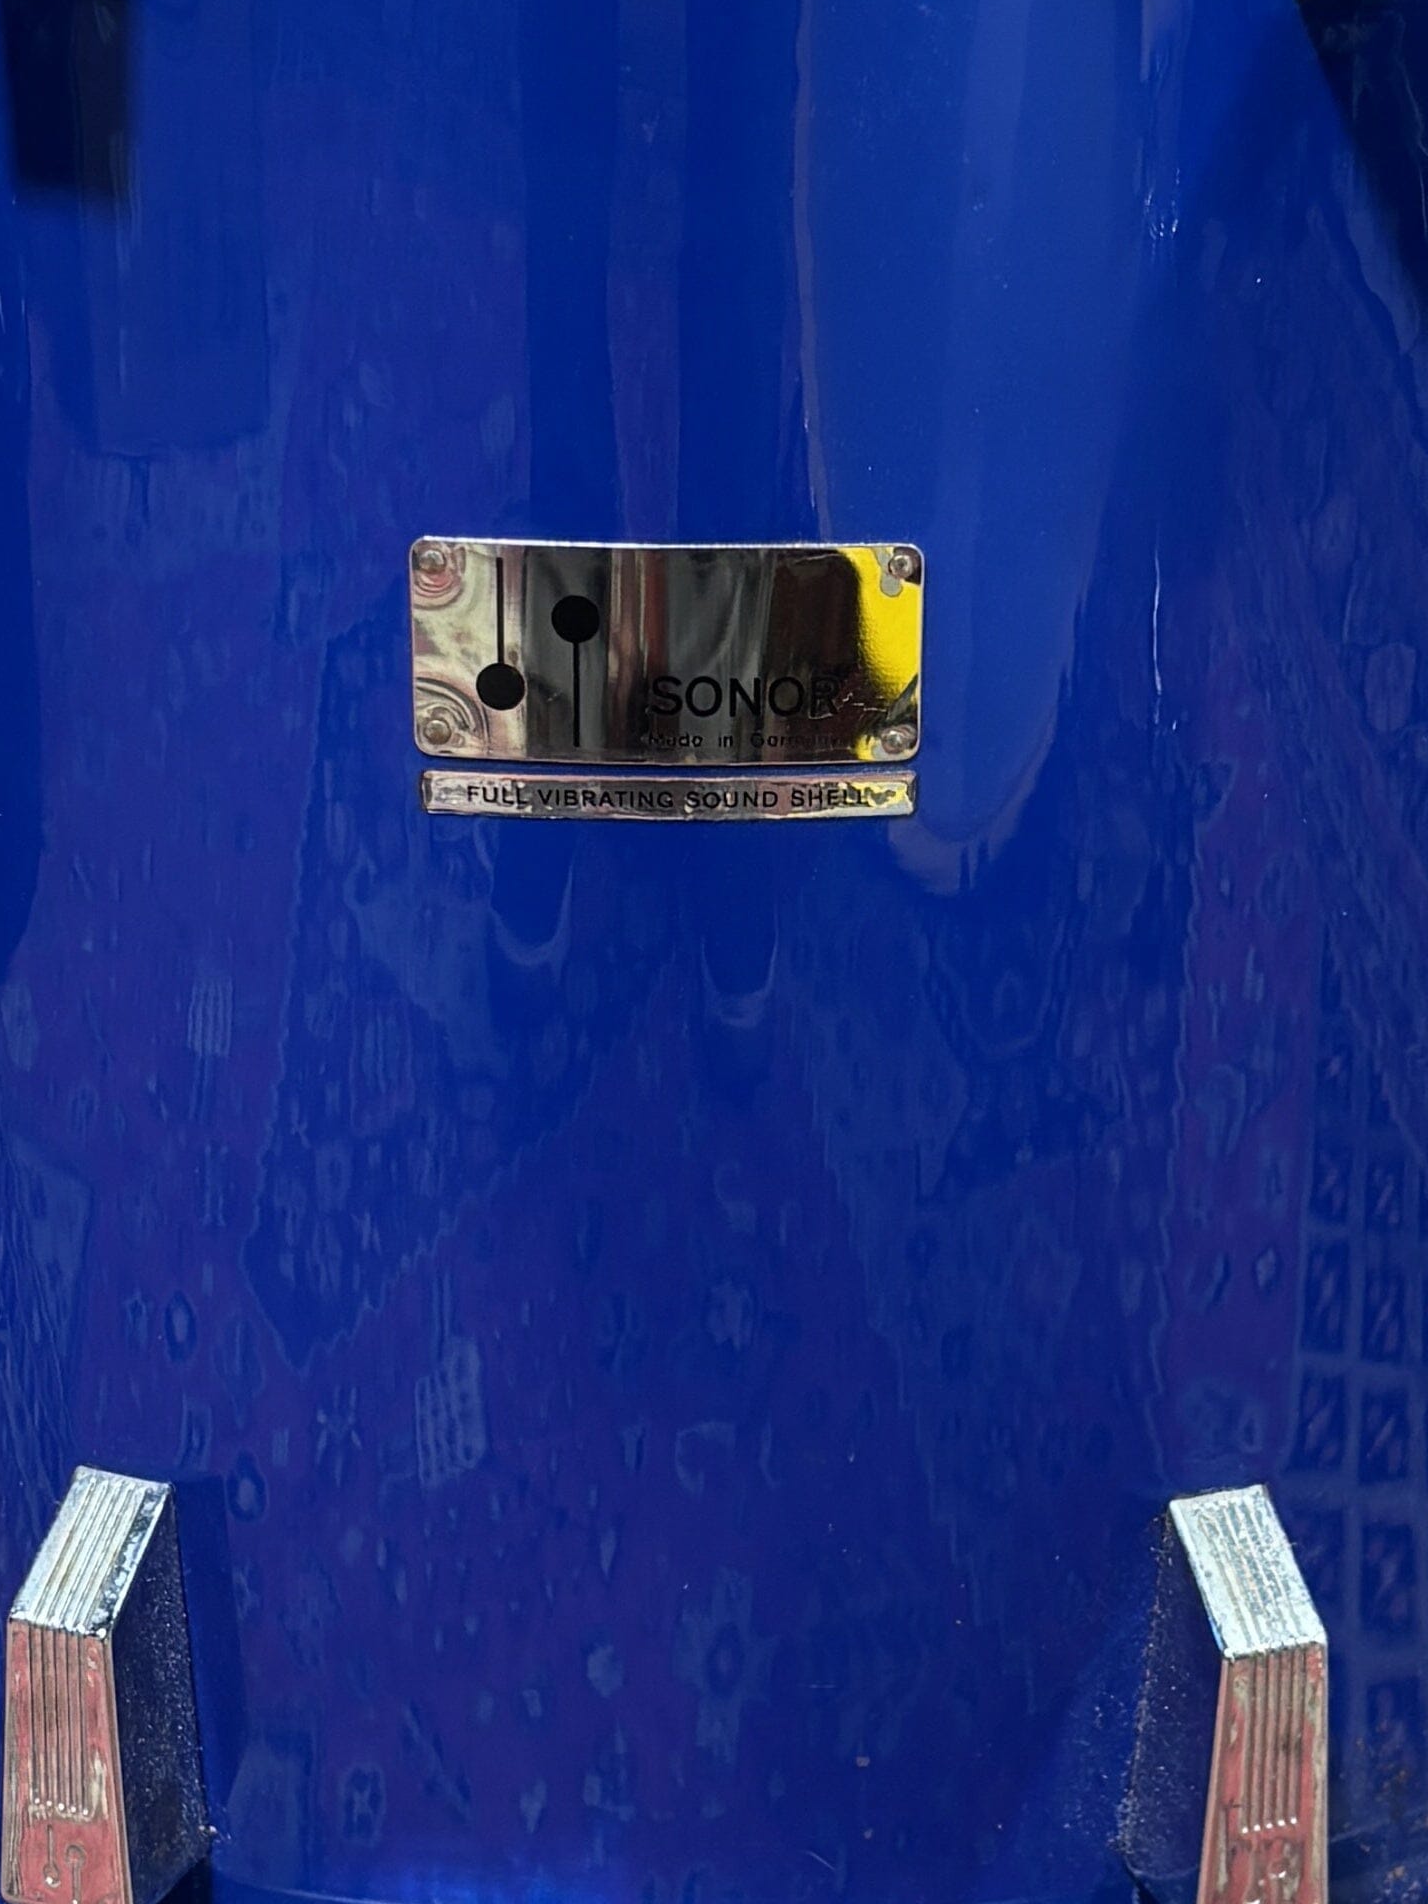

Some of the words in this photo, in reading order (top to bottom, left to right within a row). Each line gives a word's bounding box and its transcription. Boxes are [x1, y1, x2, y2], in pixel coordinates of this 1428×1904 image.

[651, 675, 840, 718] SONOR
[717, 731, 734, 748] in
[466, 785, 529, 807] FULL
[537, 788, 674, 809] VIBRATING
[685, 790, 779, 809] SOUND
[790, 787, 869, 808] SHELL
